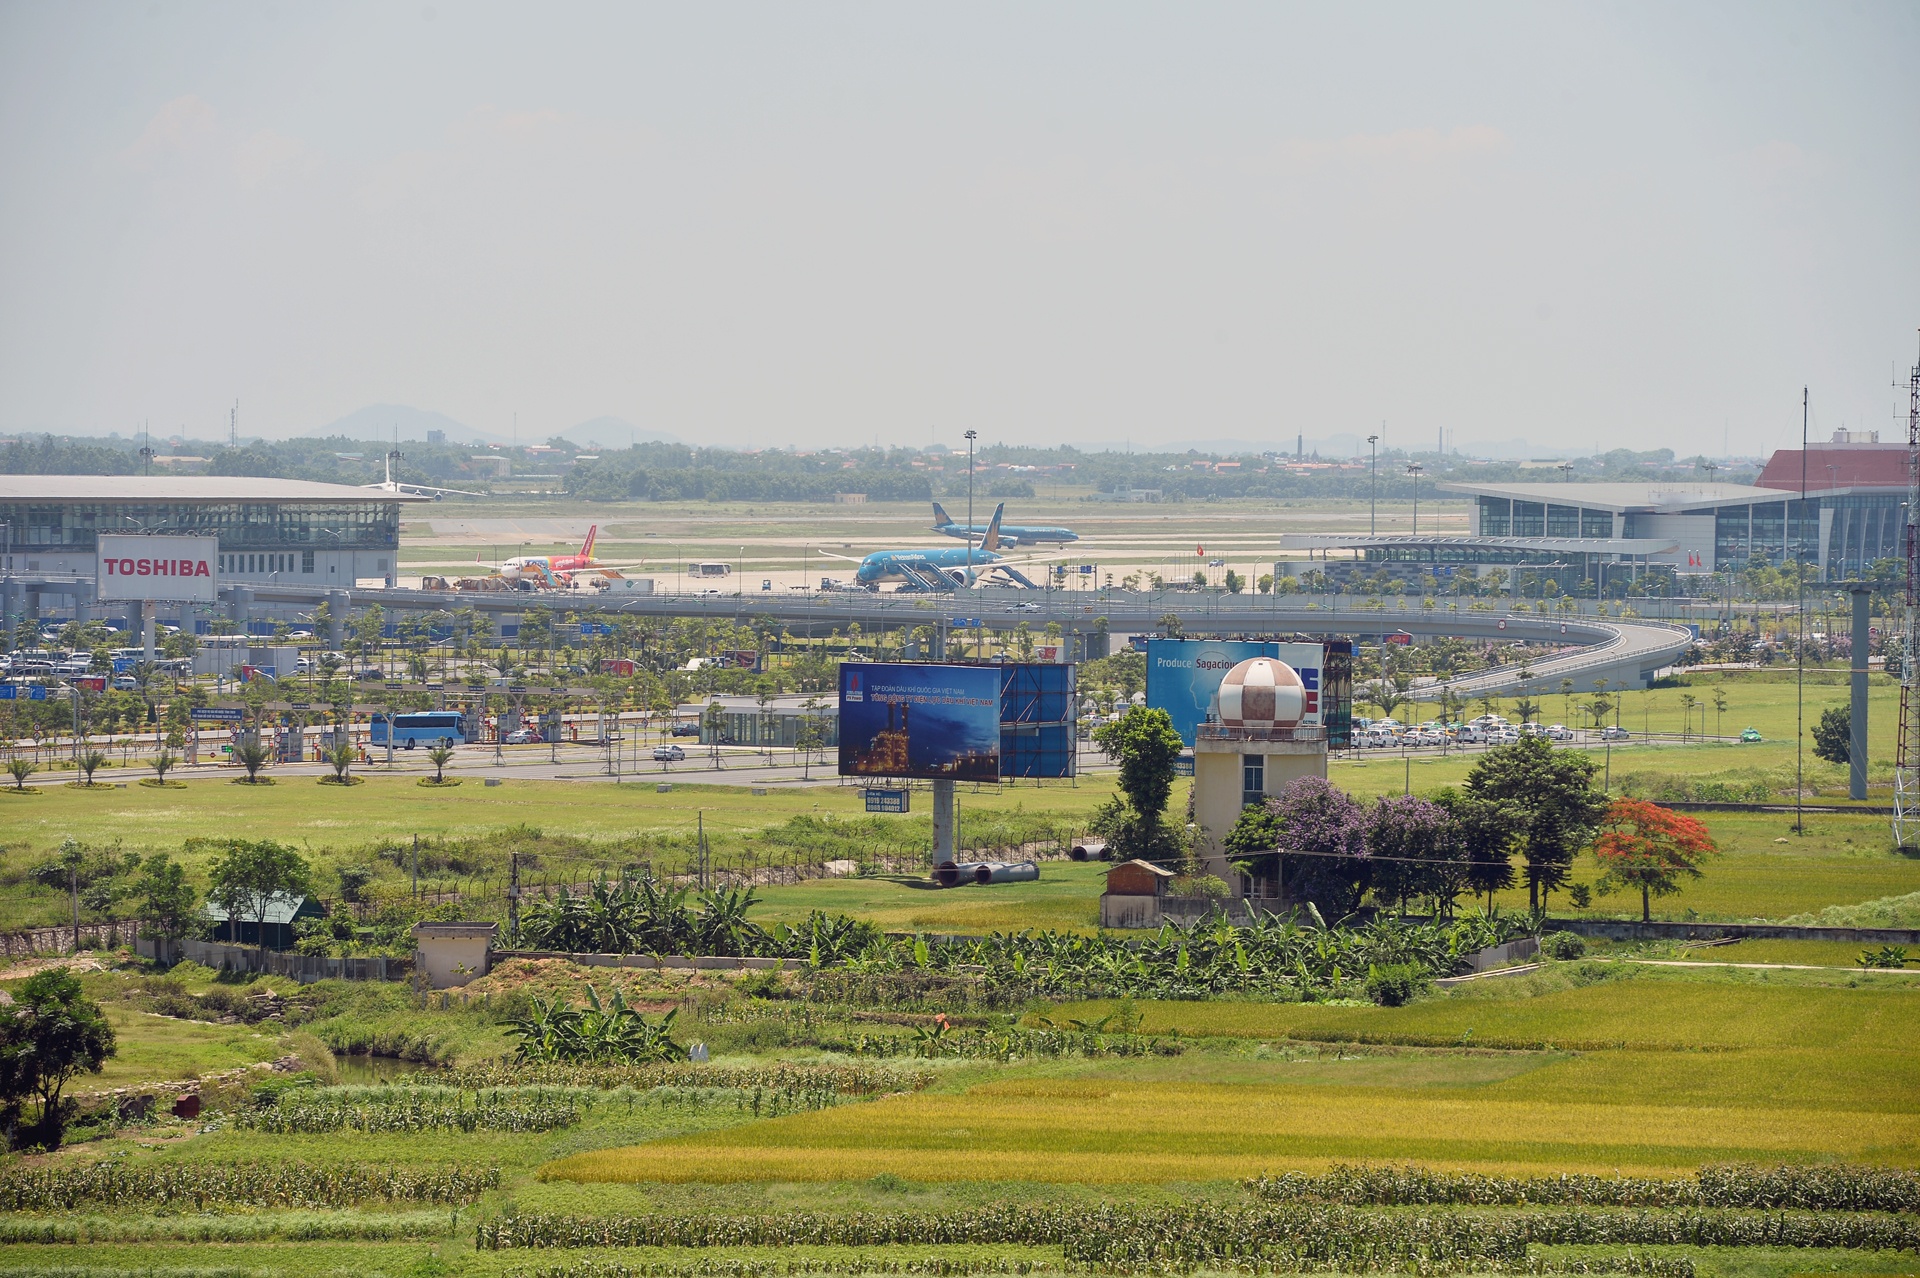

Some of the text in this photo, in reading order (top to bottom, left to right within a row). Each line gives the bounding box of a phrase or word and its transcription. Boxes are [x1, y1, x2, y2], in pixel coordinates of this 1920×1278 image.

[104, 558, 210, 577] TOSHIBA
[1157, 657, 1192, 668] Produce
[907, 685, 917, 693] KHÍ
[980, 698, 993, 706] NAM
